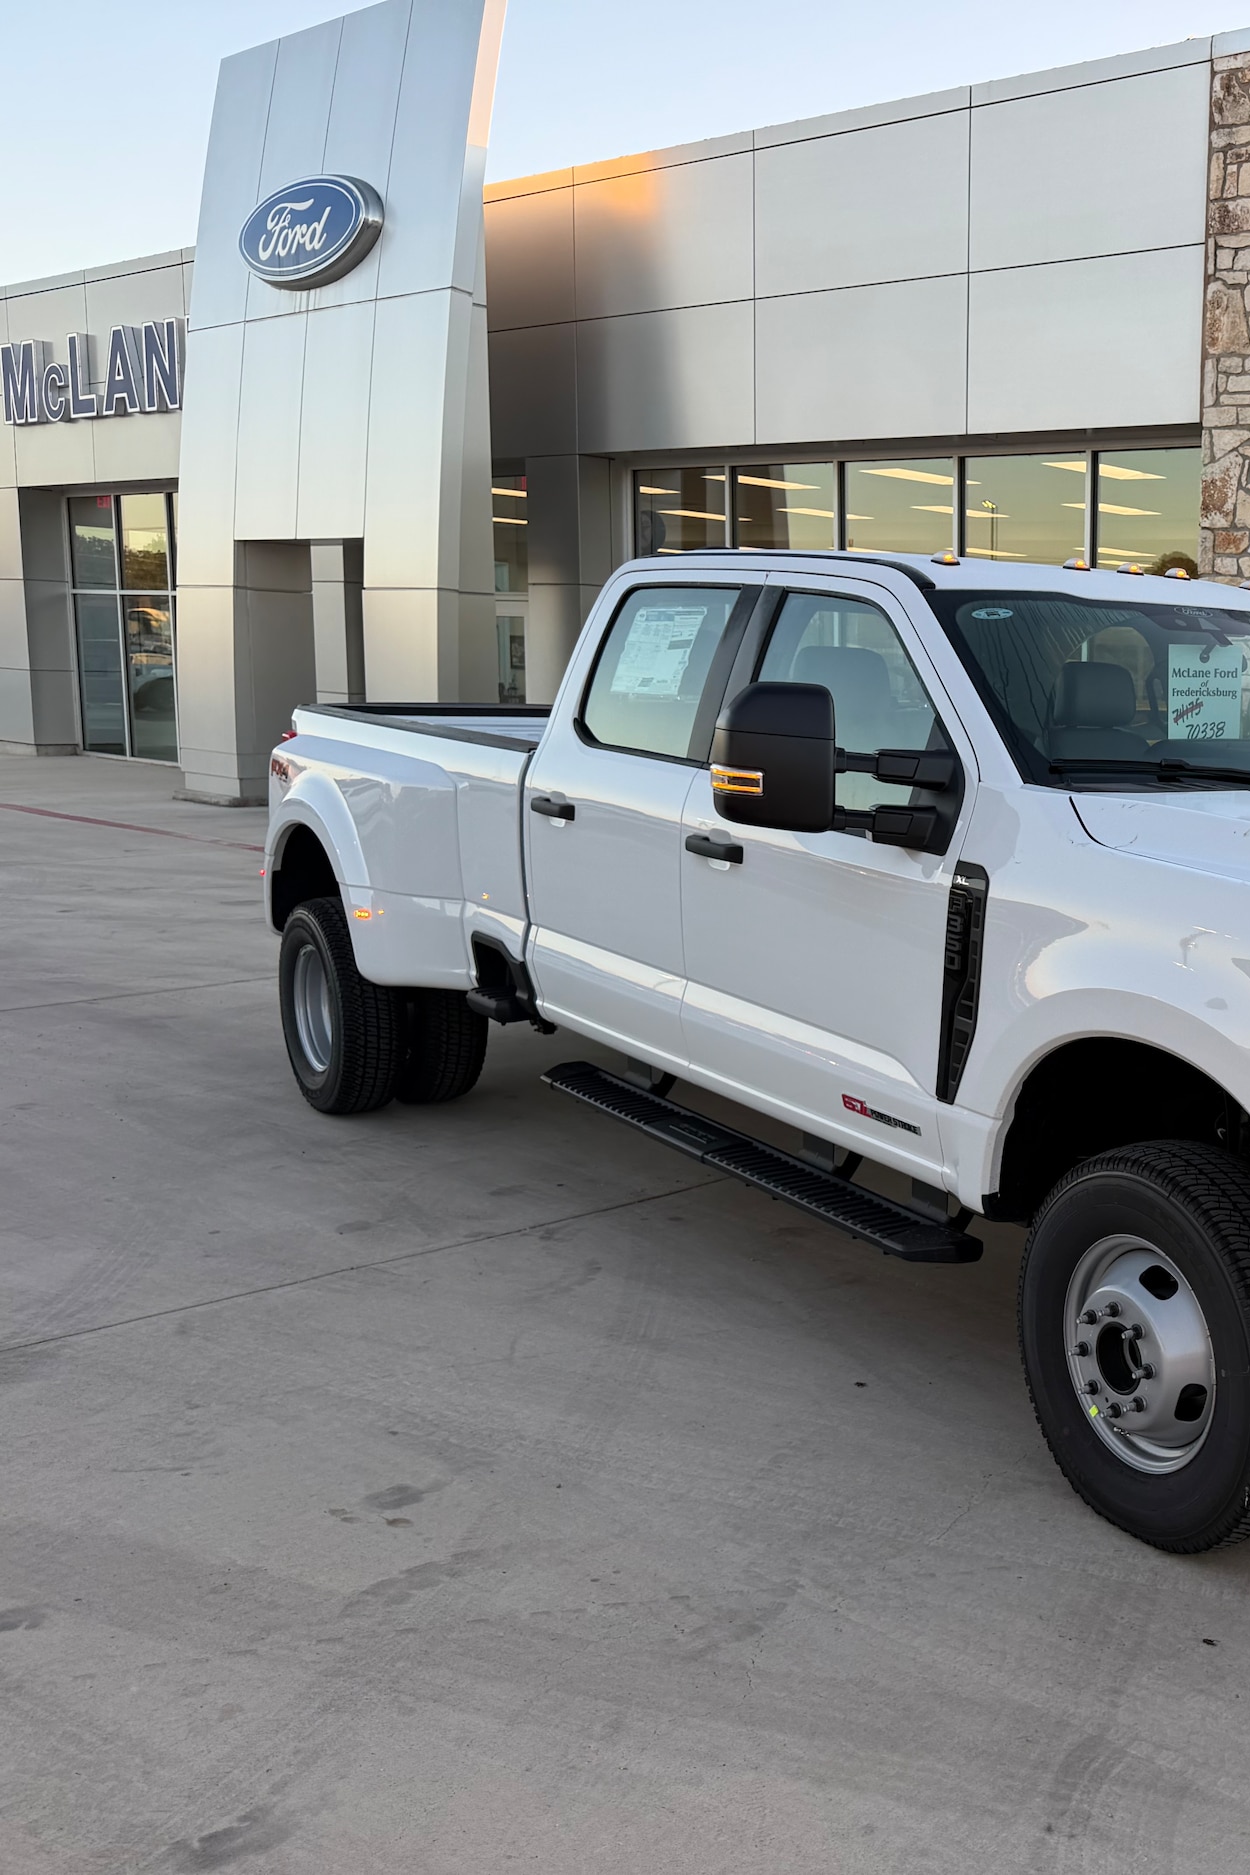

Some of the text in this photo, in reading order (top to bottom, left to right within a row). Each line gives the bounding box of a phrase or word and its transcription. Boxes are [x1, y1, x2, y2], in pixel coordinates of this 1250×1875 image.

[258, 198, 332, 261] Ford
[0, 315, 189, 425] McLAN
[1171, 667, 1238, 679] McLane Ford
[1200, 680, 1209, 688] of
[1172, 687, 1238, 700] Fredericksburg
[1185, 721, 1226, 739] 70338
[955, 875, 969, 886] XL
